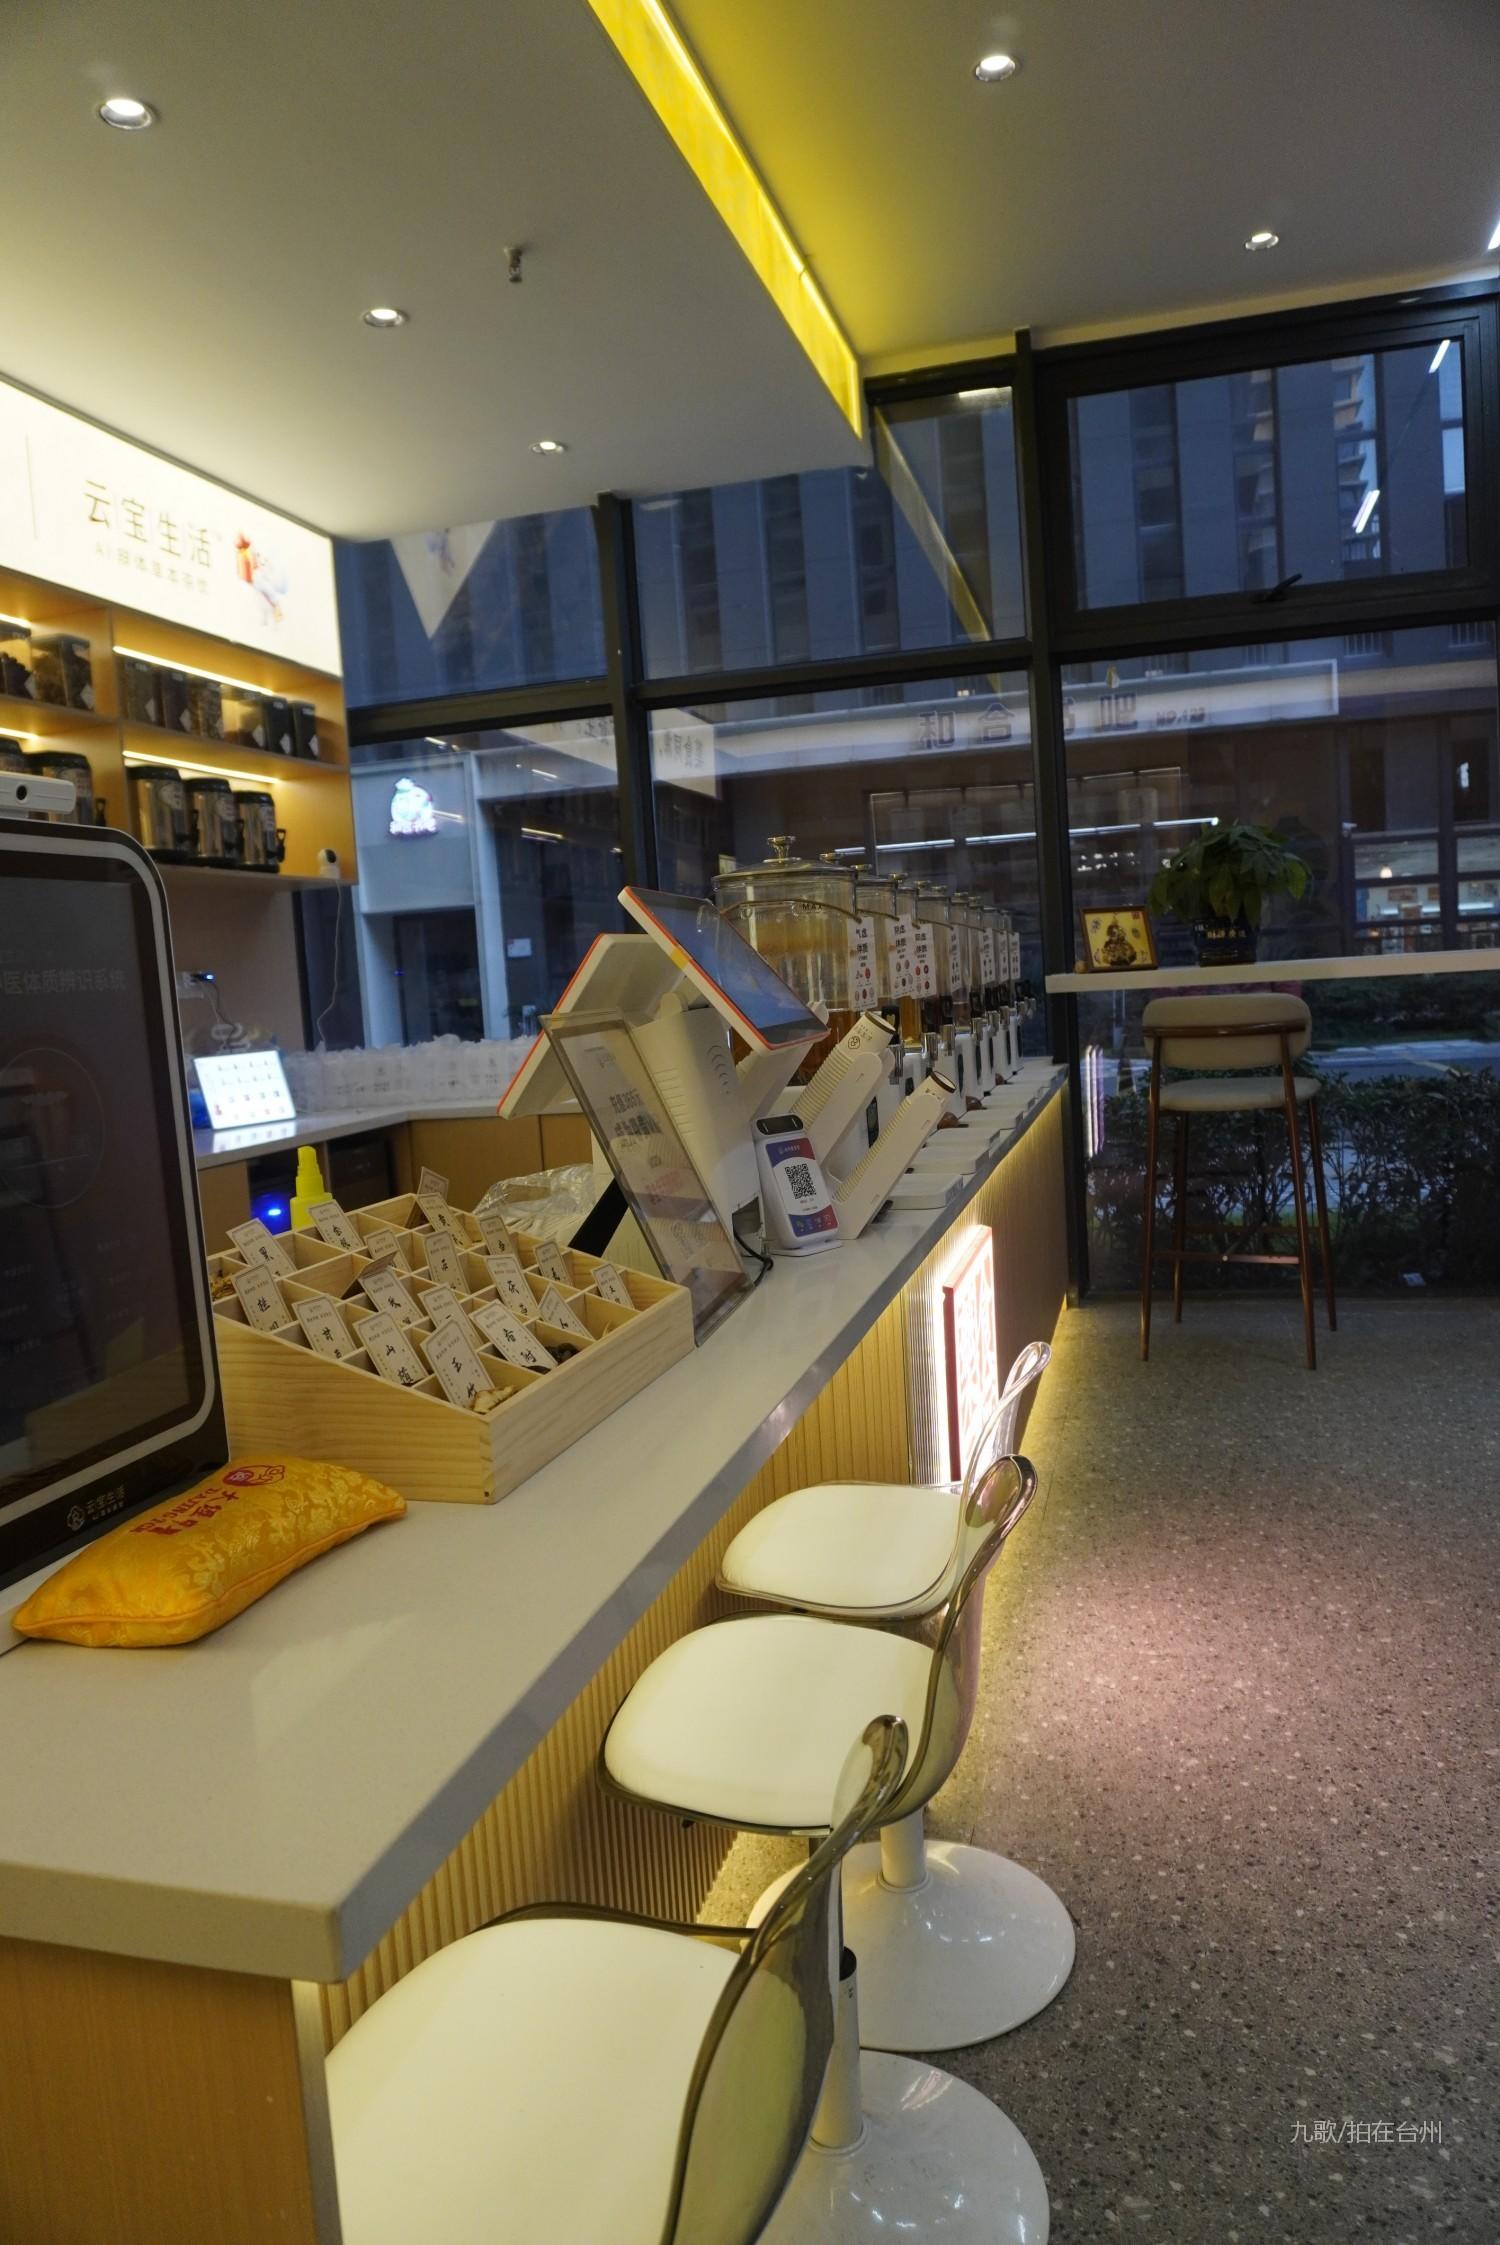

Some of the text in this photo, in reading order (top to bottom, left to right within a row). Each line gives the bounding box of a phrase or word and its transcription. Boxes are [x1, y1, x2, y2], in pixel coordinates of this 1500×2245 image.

[83, 478, 212, 569] 云宝生活
[0, 967, 128, 996] 医体质辨识系统
